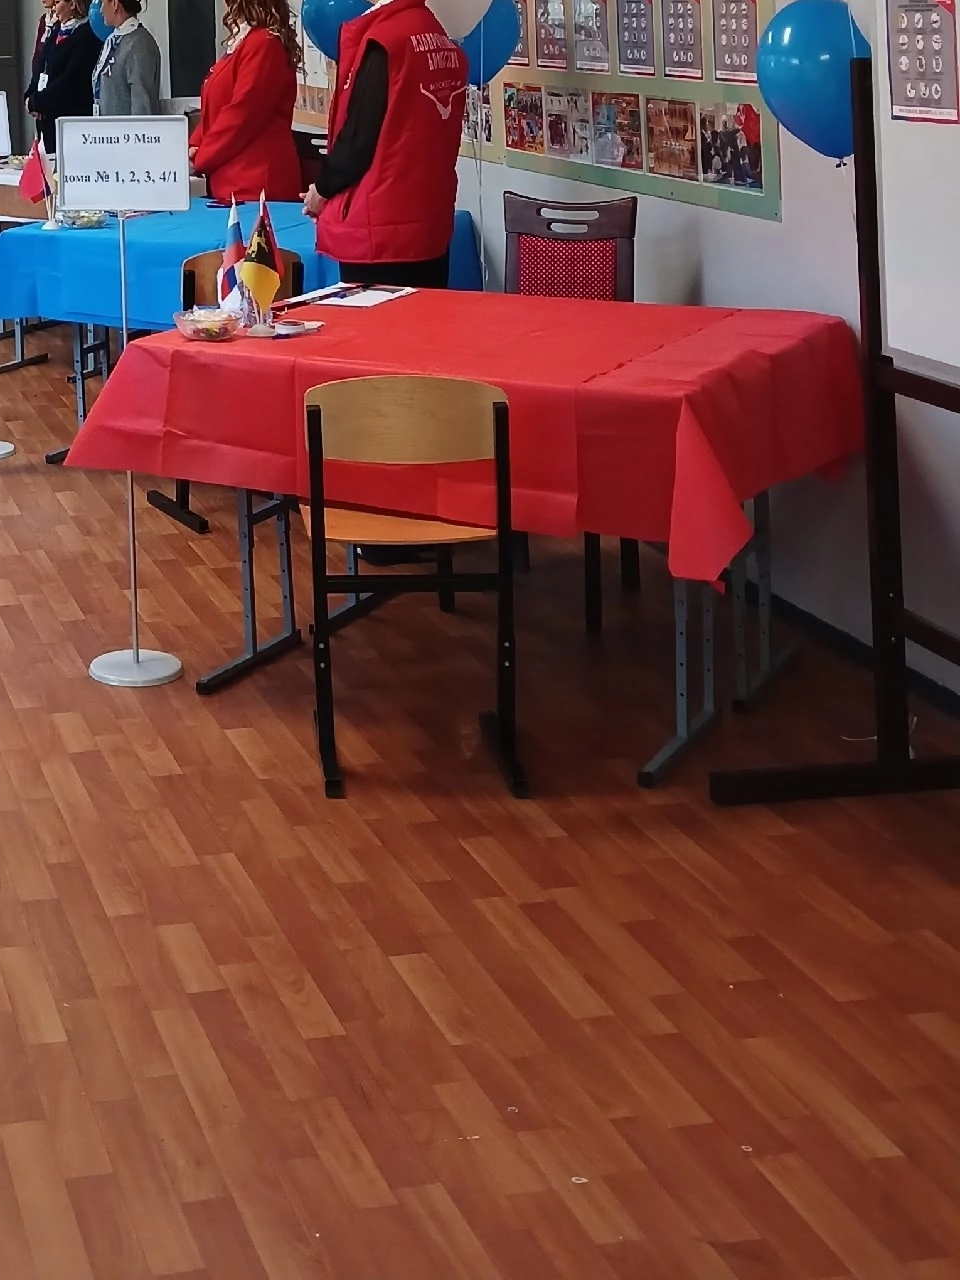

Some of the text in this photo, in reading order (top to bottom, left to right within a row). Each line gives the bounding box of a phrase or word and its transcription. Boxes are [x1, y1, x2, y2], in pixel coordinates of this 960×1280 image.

[81, 133, 161, 145] Улица 9 Мая
[62, 170, 178, 185] дома № 1, 2, 3, 4/1
